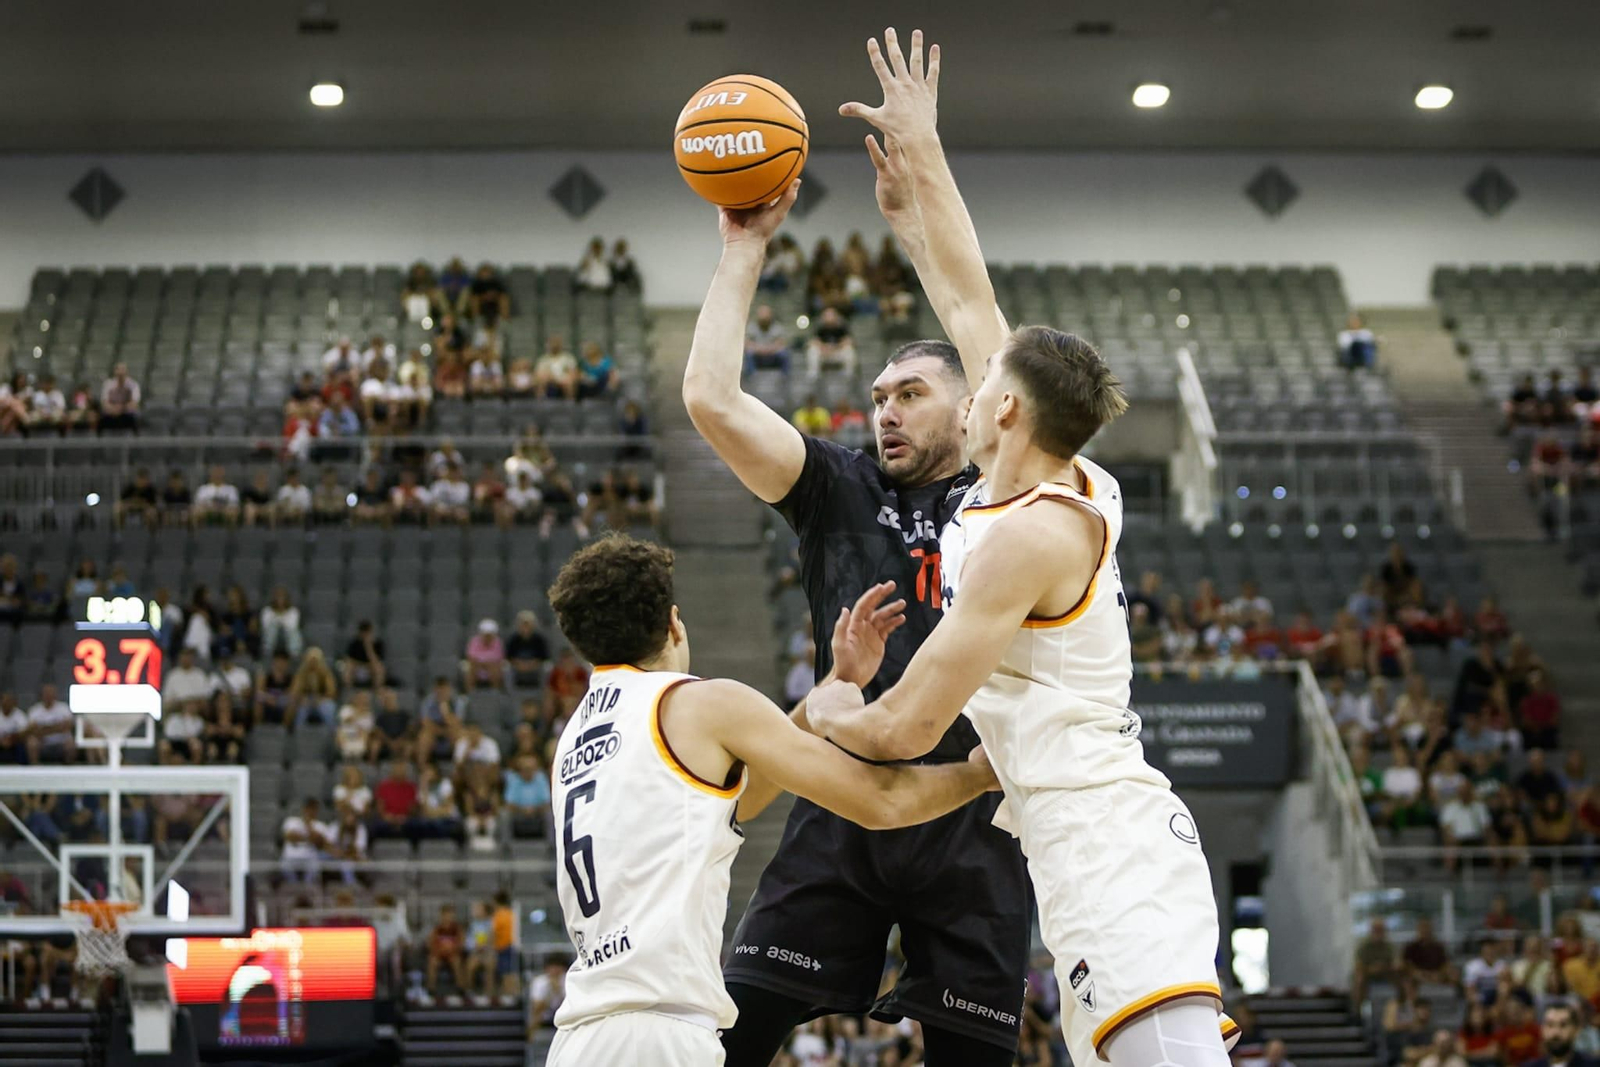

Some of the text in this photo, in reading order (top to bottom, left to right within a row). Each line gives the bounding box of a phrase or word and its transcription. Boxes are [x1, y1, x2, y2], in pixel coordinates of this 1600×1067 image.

[681, 130, 766, 159] Wilson
[74, 638, 154, 684] 3.7
[563, 779, 601, 918] 6
[735, 943, 759, 955] vive
[955, 999, 1016, 1026] BERNER
